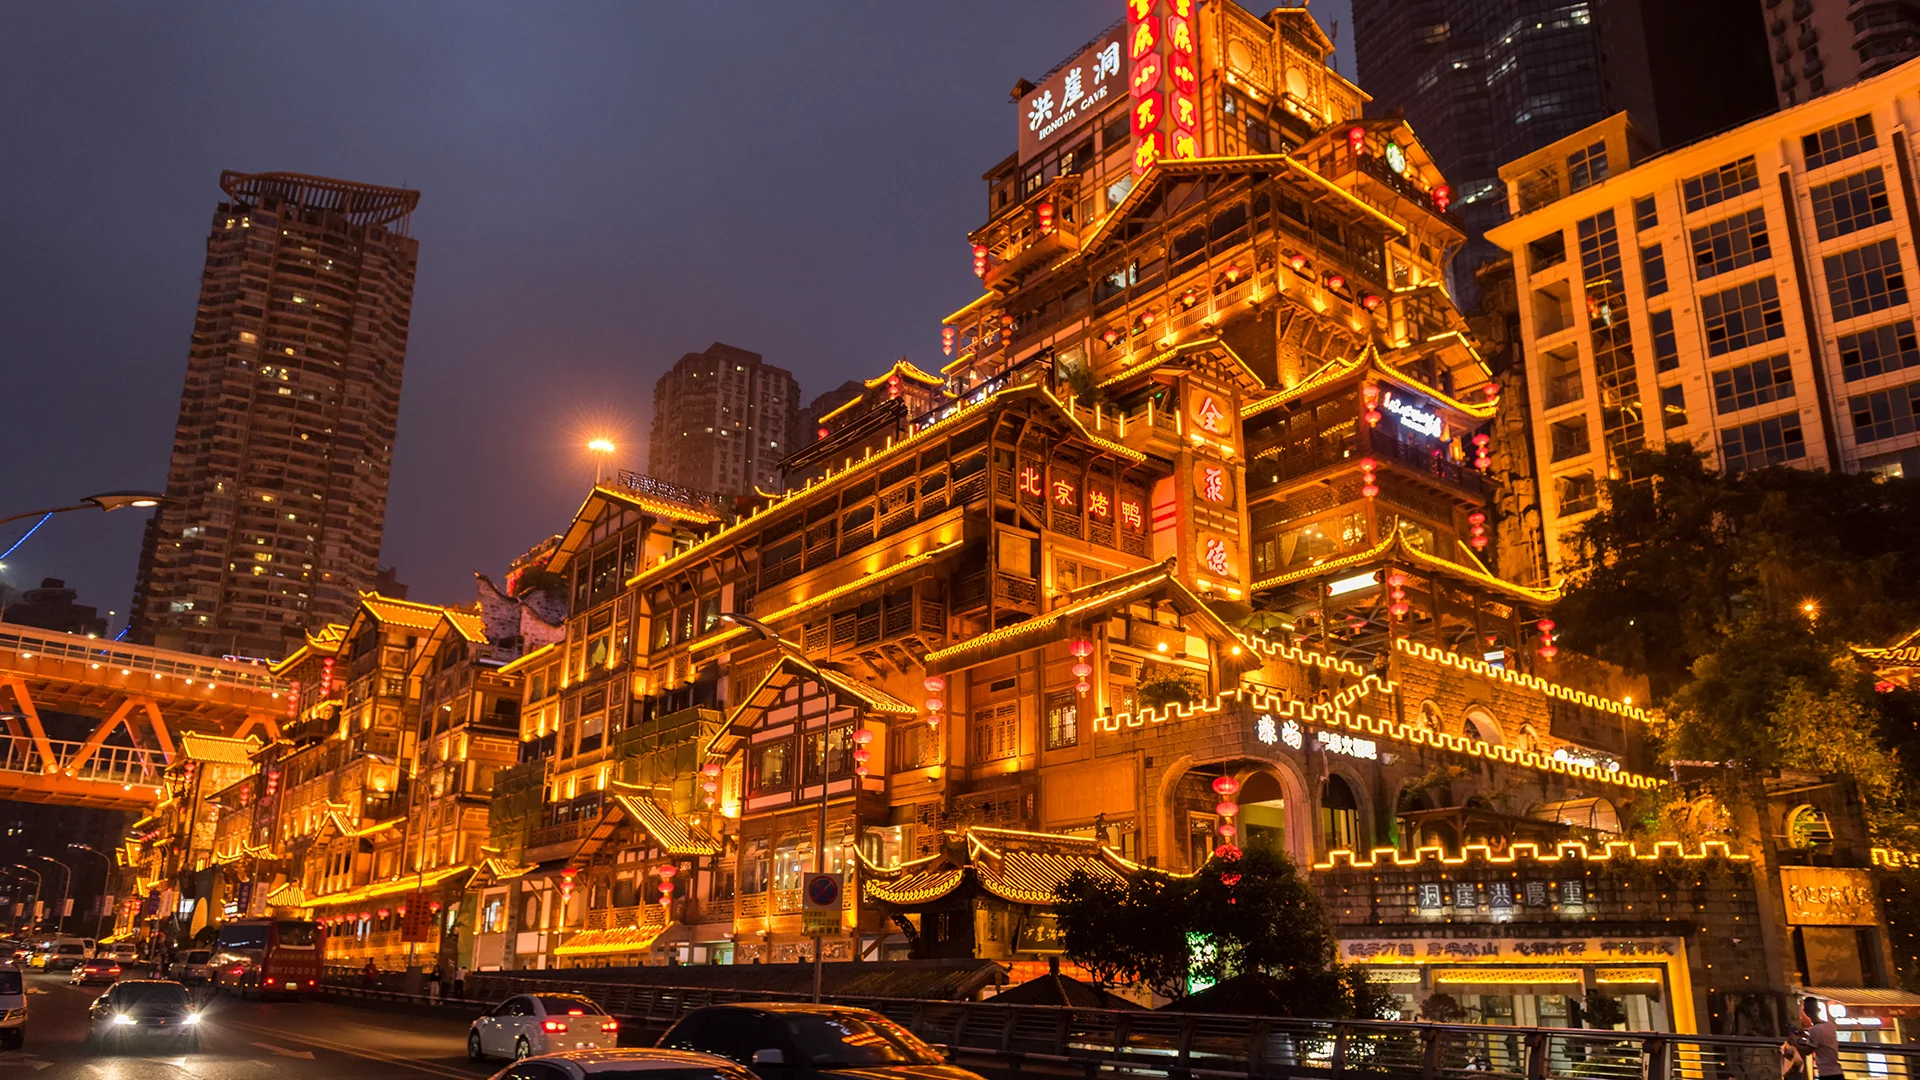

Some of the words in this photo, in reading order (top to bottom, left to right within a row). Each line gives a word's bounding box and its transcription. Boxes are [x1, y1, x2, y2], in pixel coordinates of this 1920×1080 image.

[1027, 41, 1121, 133] 洪崖洞
[1038, 109, 1077, 141] HONGYA
[1080, 85, 1108, 111] CAVE
[1020, 467, 1142, 528] 北京烤鸭
